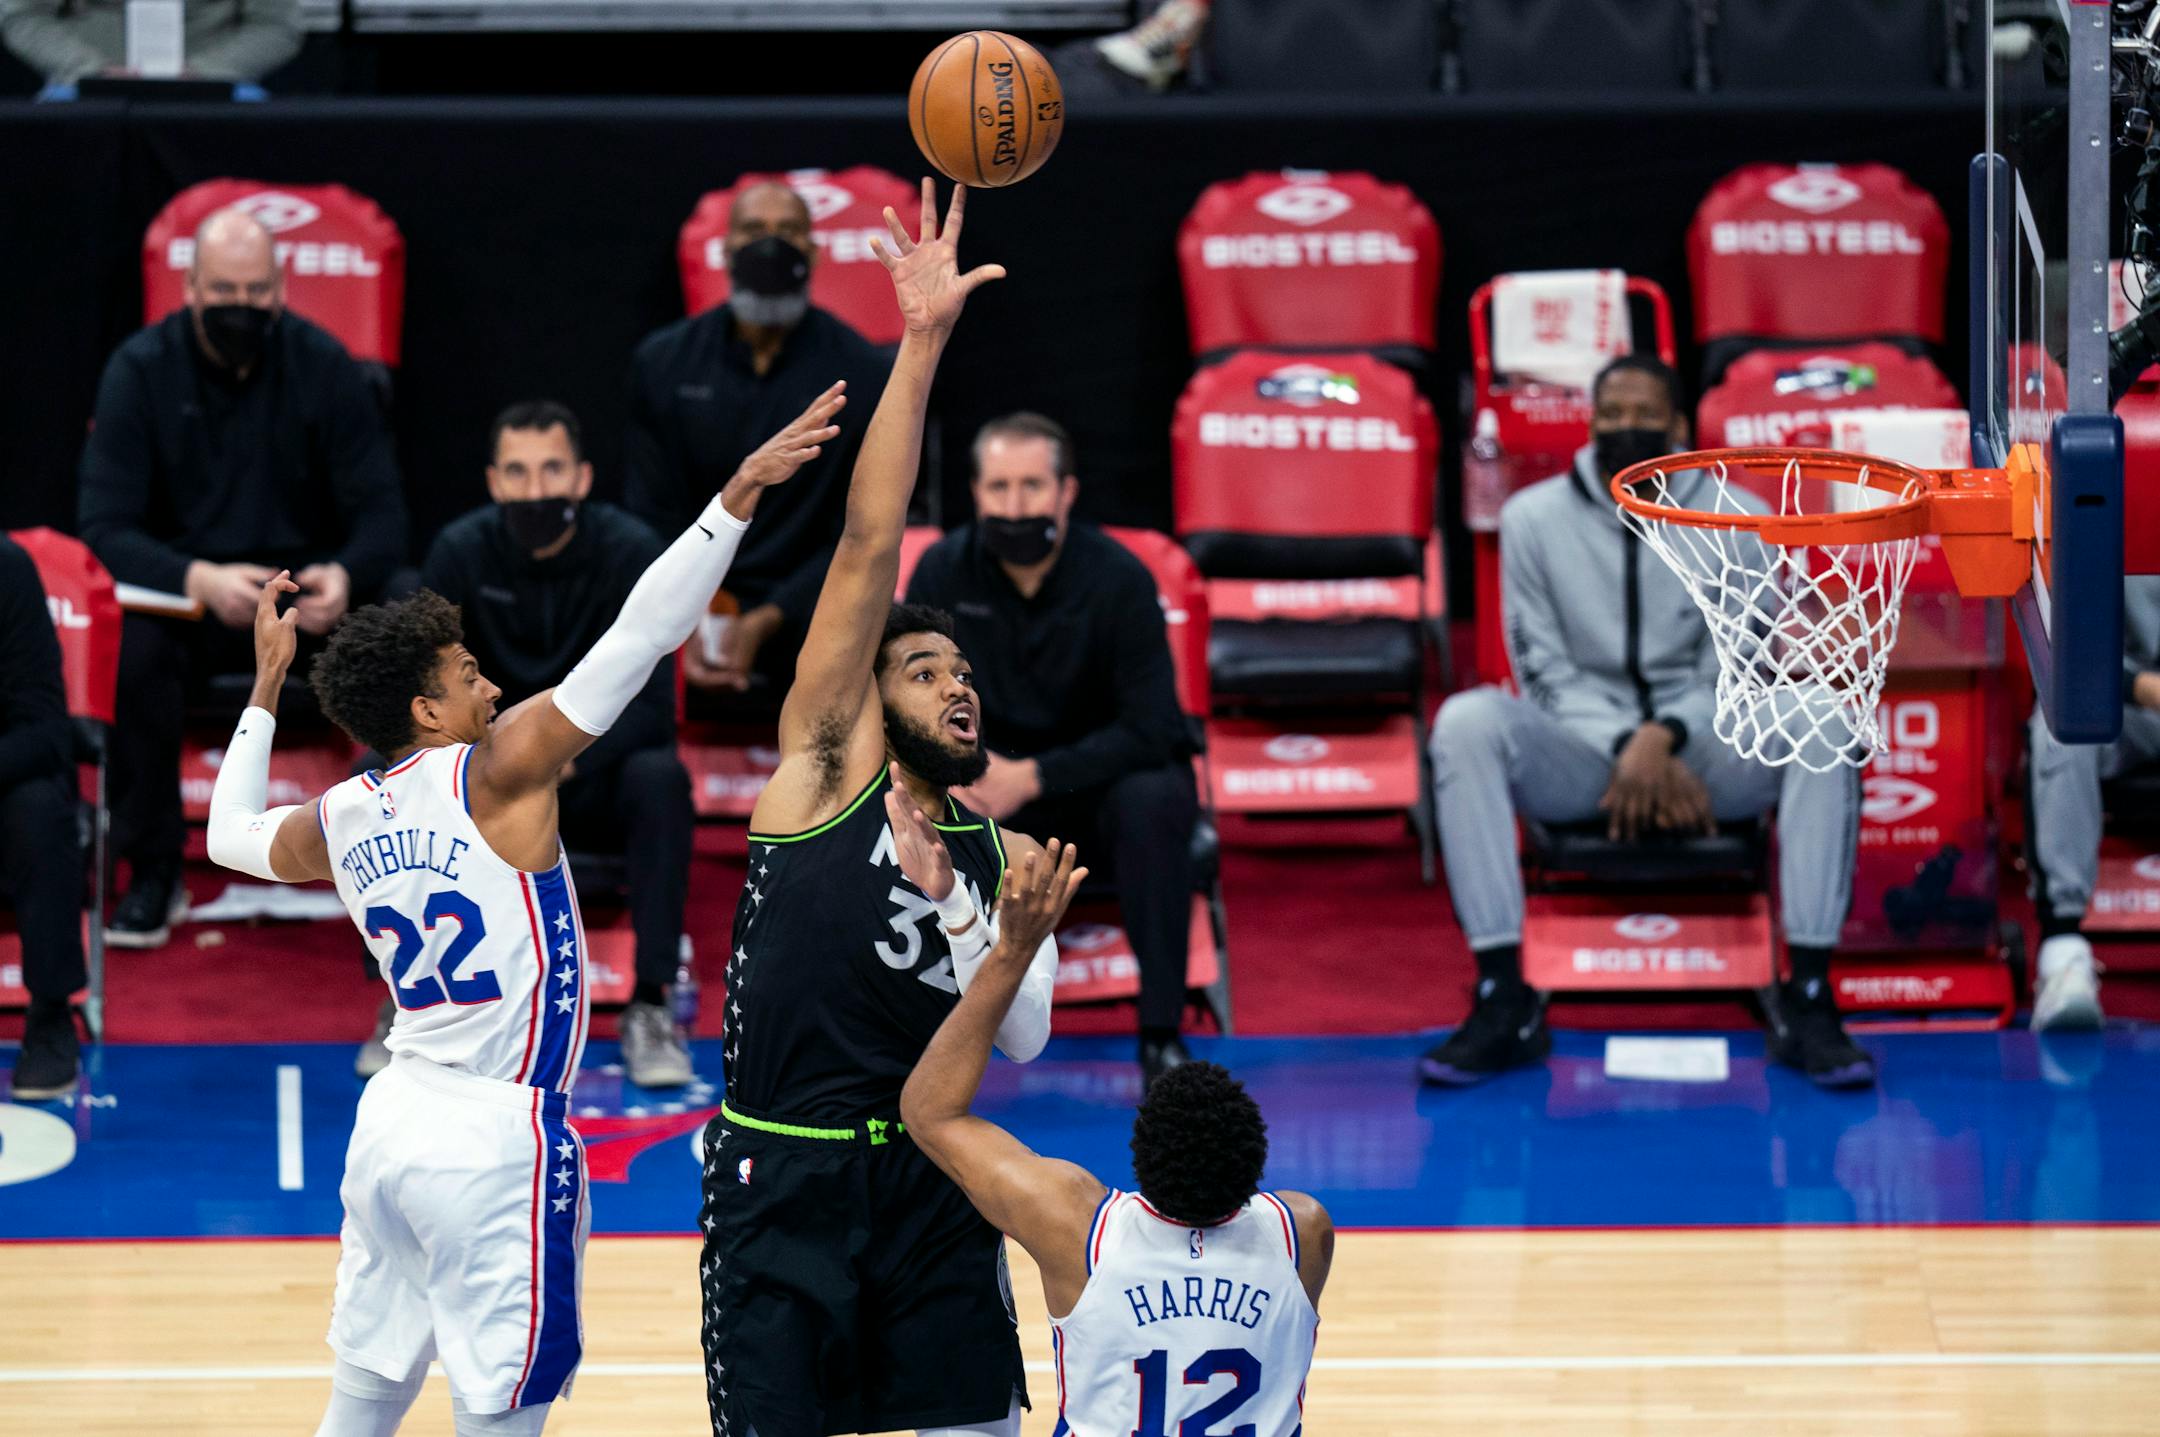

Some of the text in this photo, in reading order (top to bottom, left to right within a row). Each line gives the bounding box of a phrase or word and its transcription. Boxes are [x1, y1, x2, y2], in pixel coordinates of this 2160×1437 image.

[988, 61, 1016, 166] SPALDING
[168, 238, 381, 277] BTEEL
[1202, 231, 1417, 267] BIOSTEEL
[1712, 221, 1924, 254] BIOSTEEL
[1200, 412, 1417, 451] BIOSTEEL
[340, 828, 469, 894] THYBULLE
[365, 890, 503, 1011] 22
[1572, 948, 1727, 973] BIOSTEEL
[1124, 1276, 1271, 1329] HARRIS
[1131, 1347, 1262, 1437] 12
